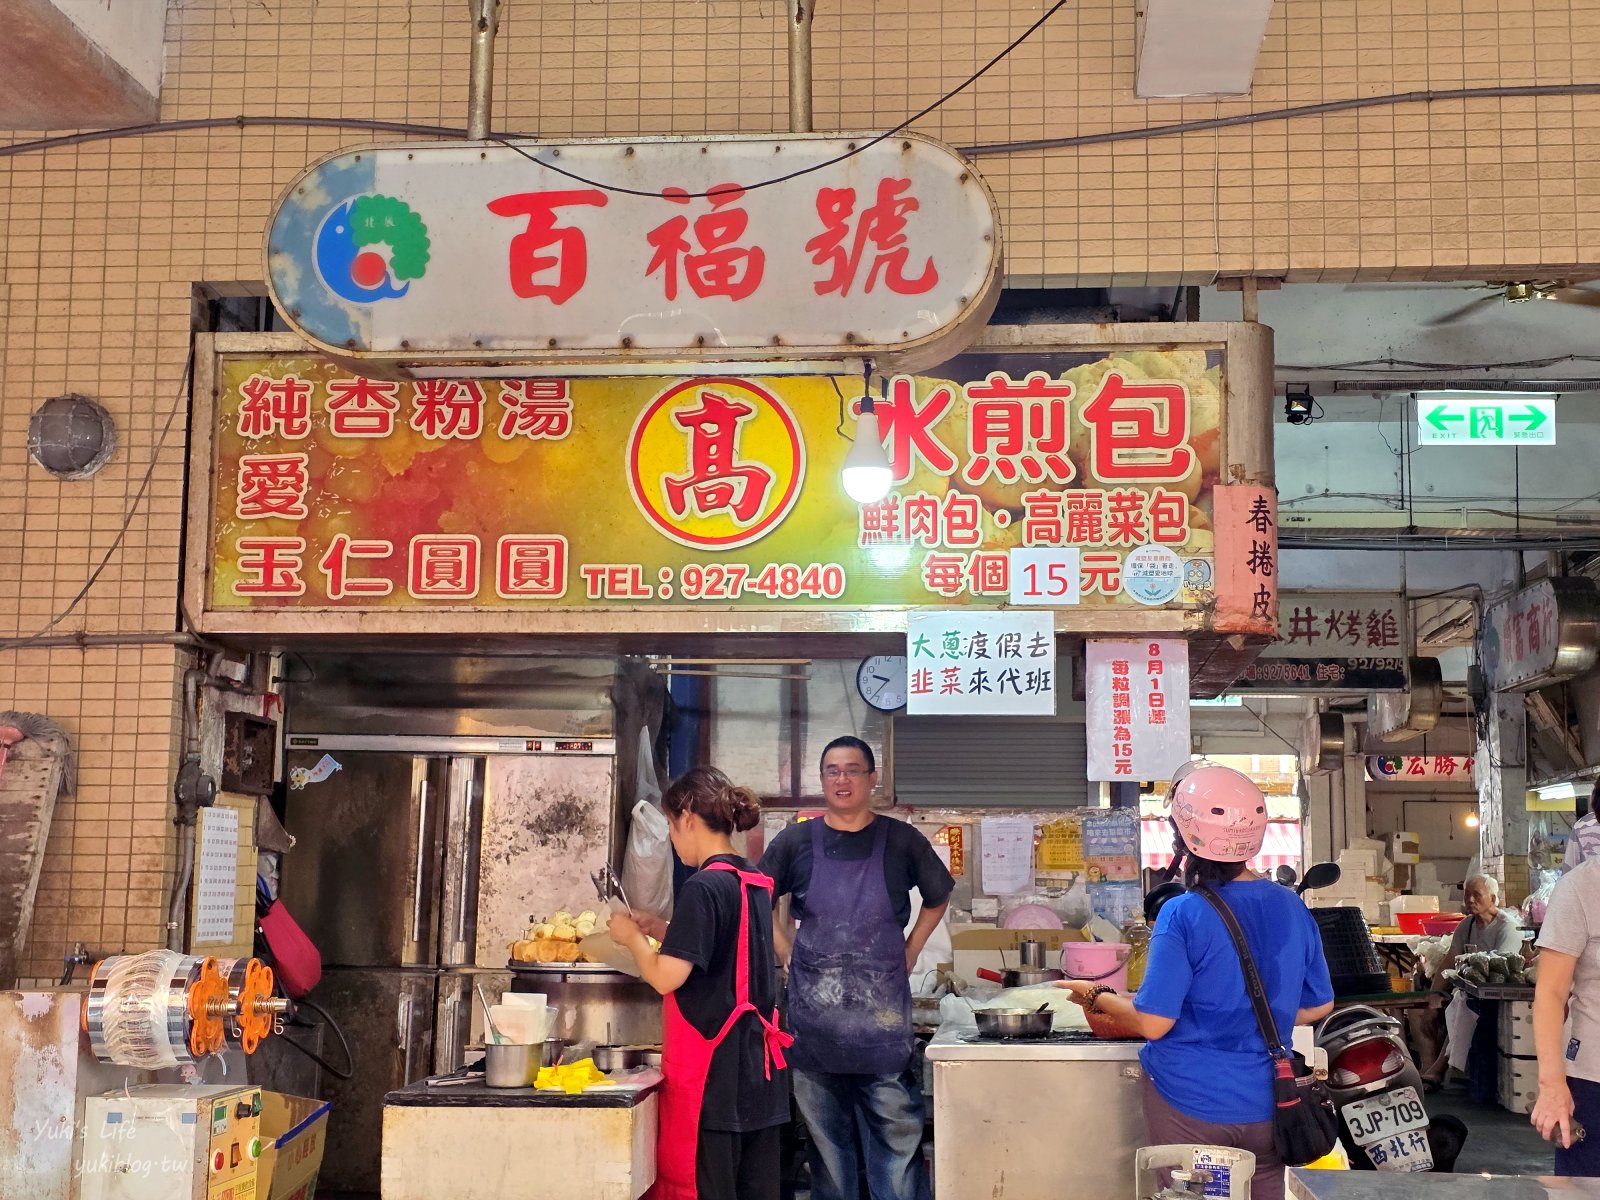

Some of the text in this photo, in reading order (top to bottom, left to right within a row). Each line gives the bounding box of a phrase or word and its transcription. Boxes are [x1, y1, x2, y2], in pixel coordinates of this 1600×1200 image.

[487, 177, 939, 304] 百福號
[851, 373, 1192, 482] 水煎包
[1513, 431, 1544, 439] 緊急出口
[1246, 494, 1274, 621] 春捲皮
[1277, 606, 1400, 648] 井烤雞
[910, 666, 1052, 695] 韭菜來代班
[1368, 1131, 1427, 1165] 西北行
